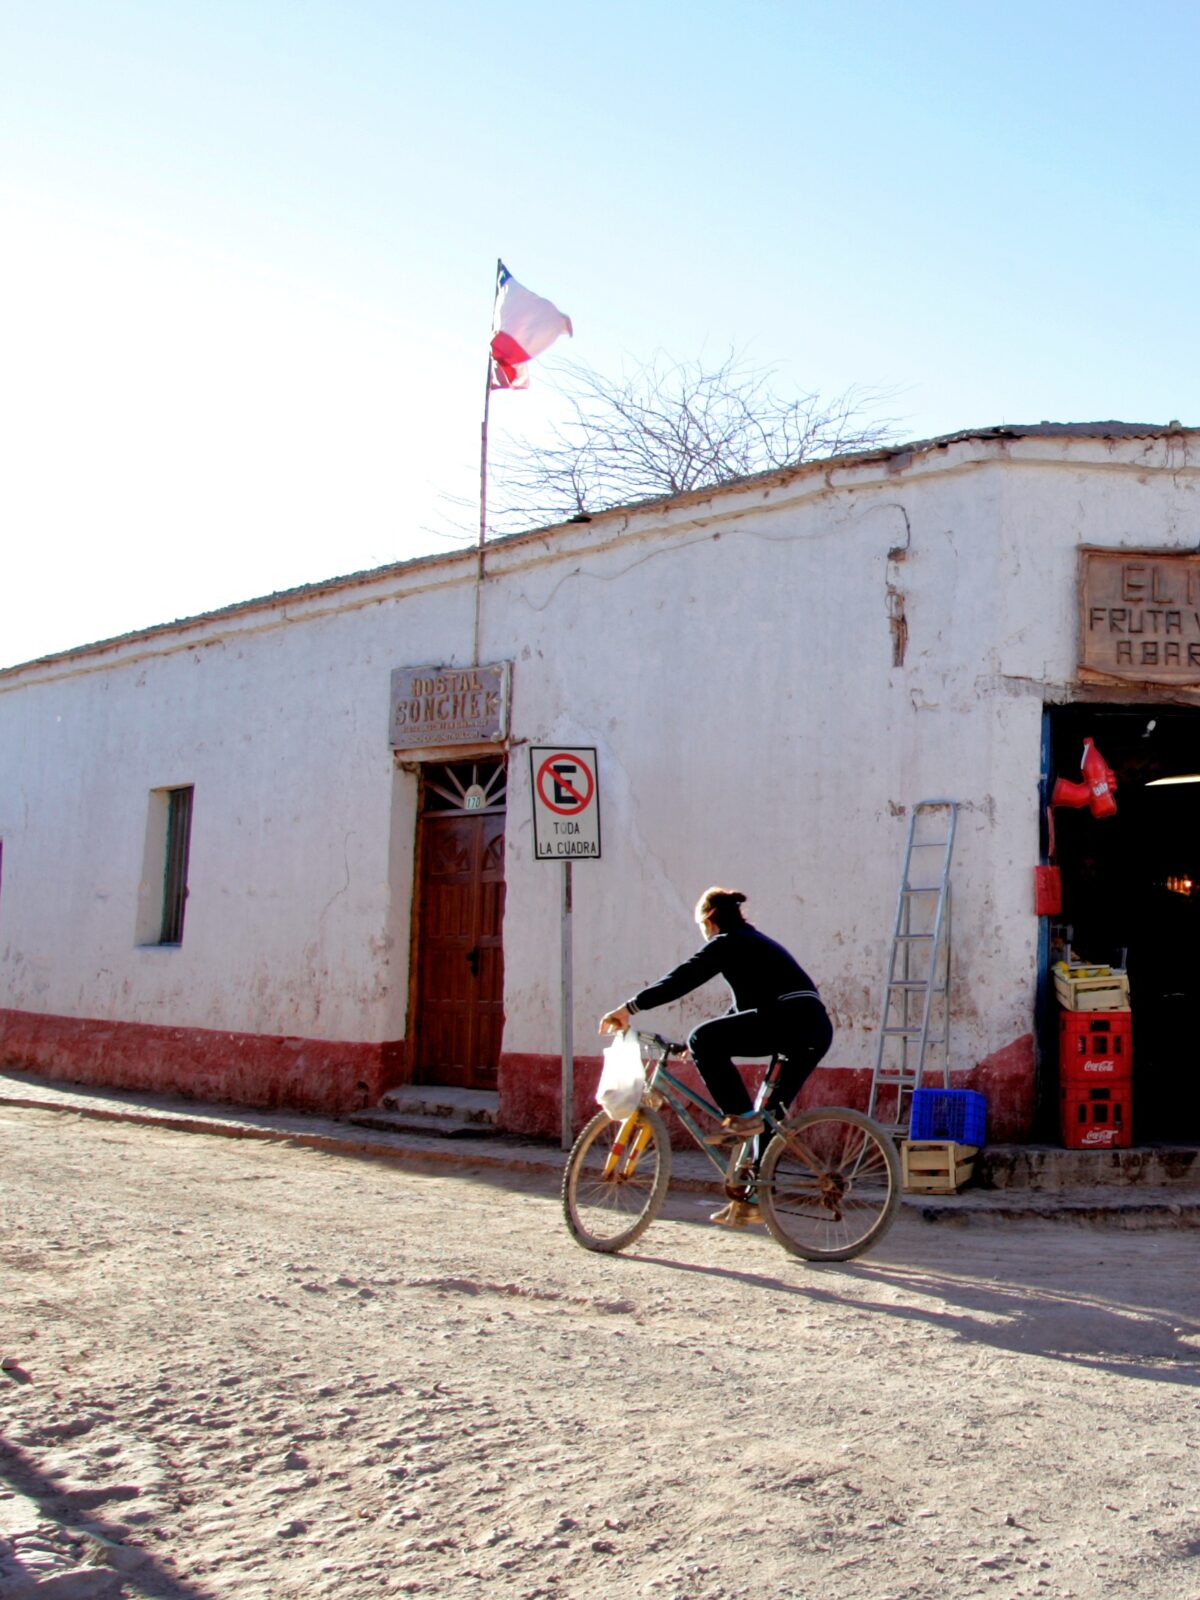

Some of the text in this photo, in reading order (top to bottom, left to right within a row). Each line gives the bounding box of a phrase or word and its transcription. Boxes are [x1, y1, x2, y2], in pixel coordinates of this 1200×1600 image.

[1121, 563, 1173, 603] EL
[1090, 607, 1183, 635] FRUTA
[411, 671, 484, 698] HOSTAL
[395, 691, 499, 726] SONCHEK
[553, 765, 578, 804] E
[553, 821, 581, 835] TODA
[539, 841, 597, 855] LA CUADRA
